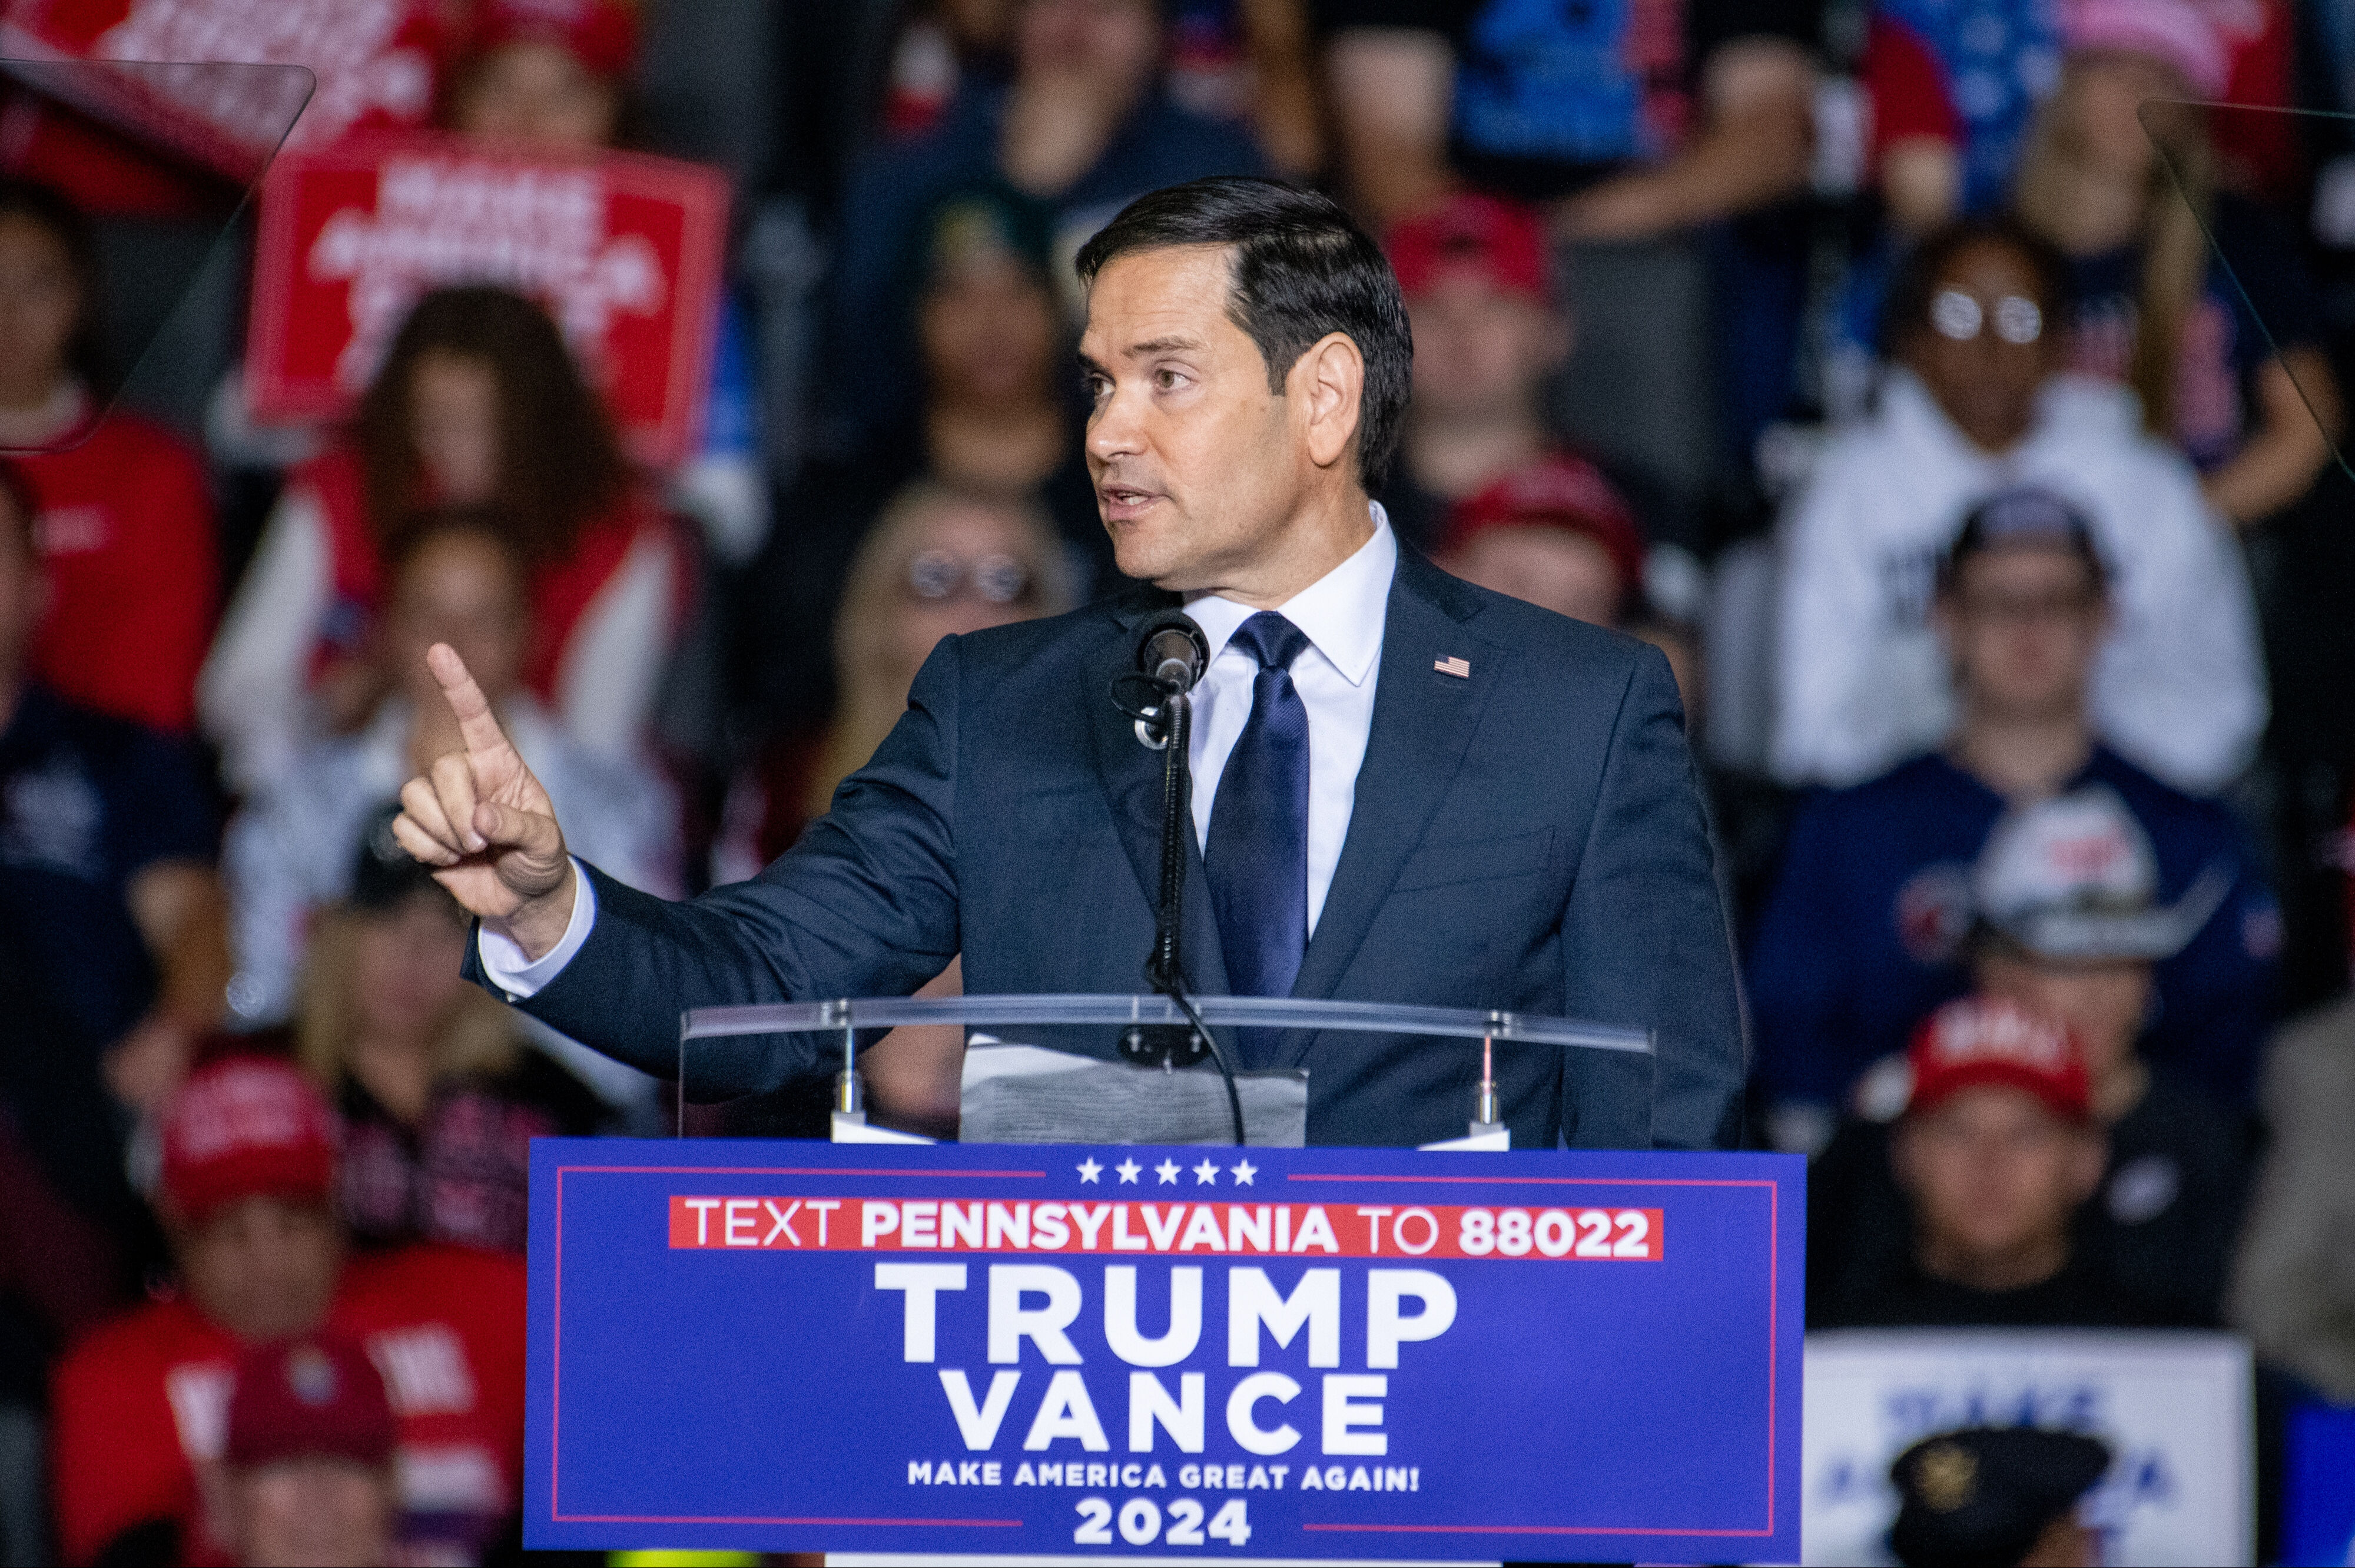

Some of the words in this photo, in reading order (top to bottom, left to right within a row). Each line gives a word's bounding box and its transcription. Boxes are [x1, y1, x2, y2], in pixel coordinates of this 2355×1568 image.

[684, 1198, 841, 1247] TEXT
[861, 1201, 1340, 1254] PENNSYLVANIA
[1356, 1206, 1439, 1255] TO
[1458, 1208, 1650, 1258] 88022
[874, 1262, 1458, 1370] TRUMP
[938, 1368, 1388, 1457] VANCE
[907, 1461, 1002, 1486] MAKE
[1013, 1462, 1167, 1488] AMERICA
[1178, 1464, 1289, 1490] GREAT
[1300, 1465, 1419, 1492] AGAIN!
[1073, 1497, 1252, 1546] 2024
